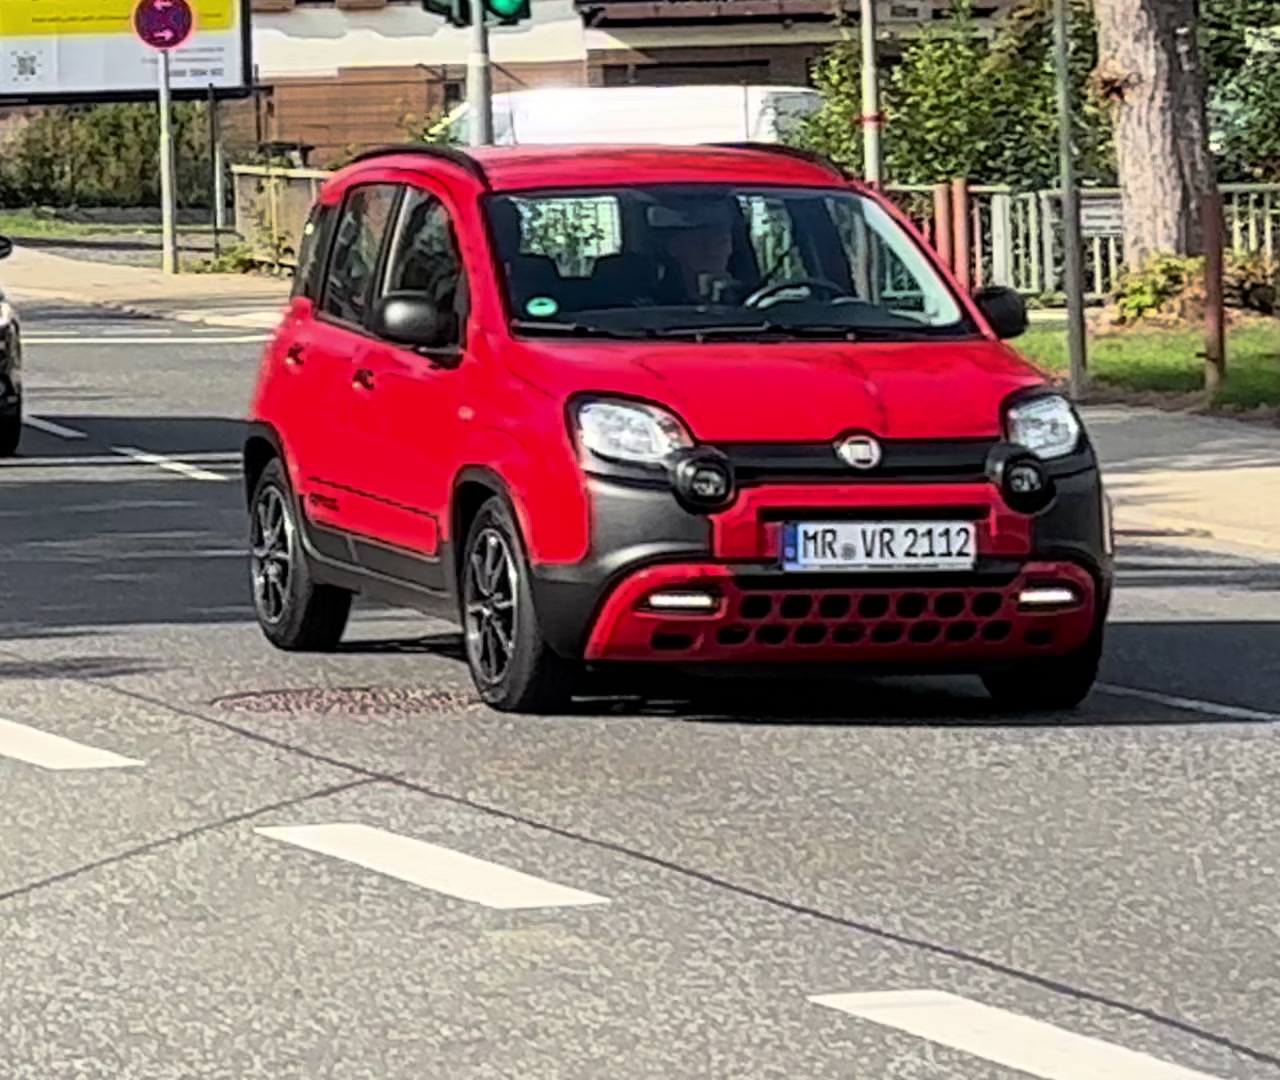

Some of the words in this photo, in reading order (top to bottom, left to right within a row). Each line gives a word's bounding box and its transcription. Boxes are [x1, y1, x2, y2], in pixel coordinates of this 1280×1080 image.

[802, 528, 837, 559] MR
[861, 527, 896, 559] VR
[903, 527, 971, 558] 2112
